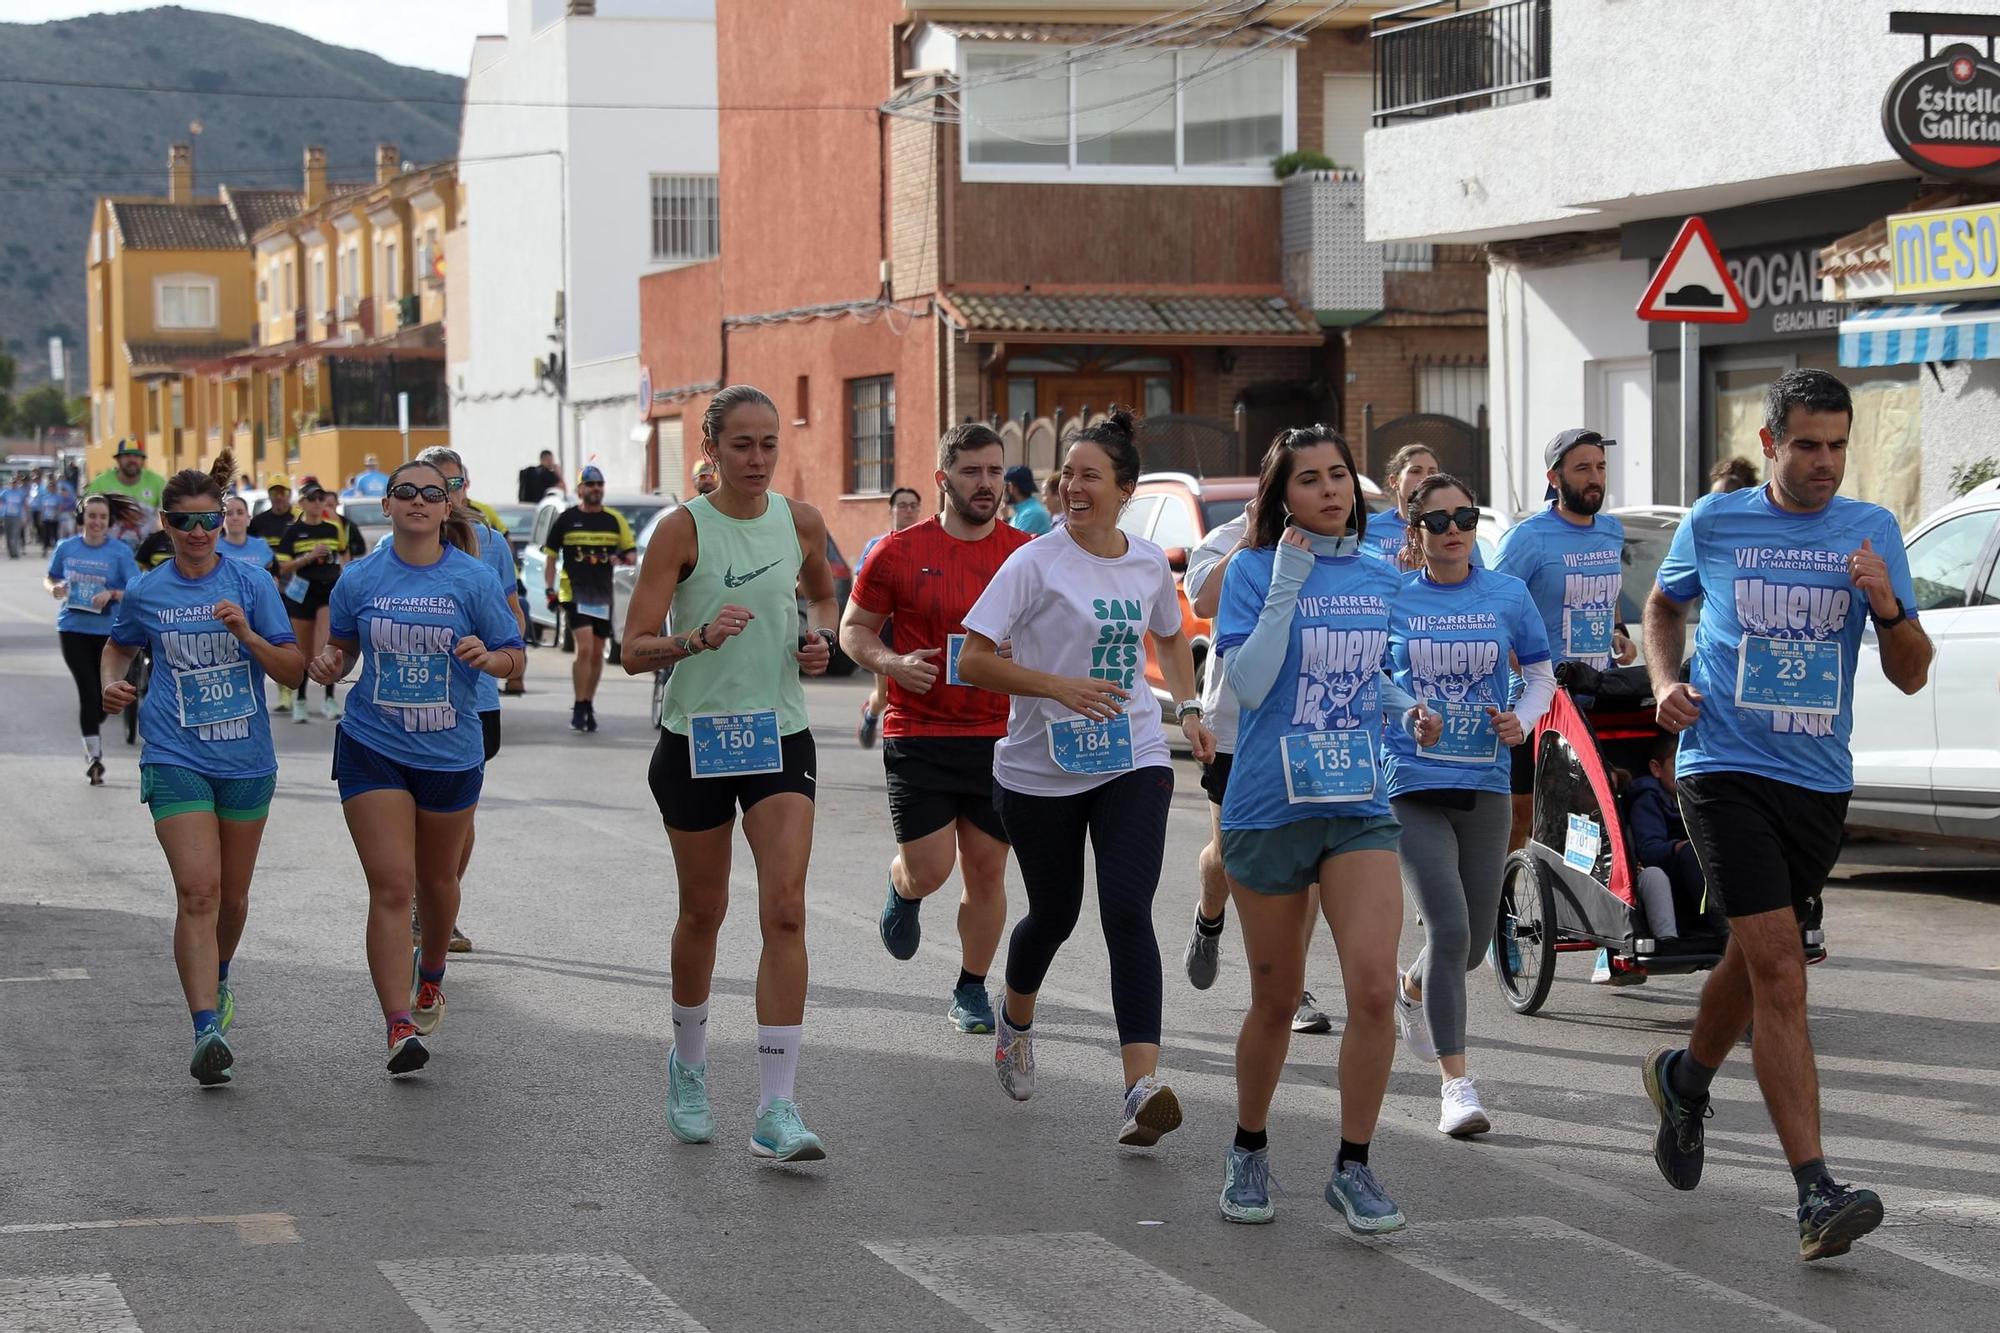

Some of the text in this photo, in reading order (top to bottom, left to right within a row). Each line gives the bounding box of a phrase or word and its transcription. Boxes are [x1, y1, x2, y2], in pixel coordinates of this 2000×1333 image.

[1917, 84, 2000, 114] Estrella
[1919, 112, 2000, 141] Galicia
[1896, 215, 2000, 286] MESO
[1773, 311, 1815, 333] GRACIA
[1380, 538, 1393, 549] VII
[1562, 553, 1577, 567] VII
[1735, 548, 1849, 569] VII CARRERA
[1760, 560, 1849, 573] Y MARCHA URBAN
[373, 597, 455, 610] VII CARRERA
[428, 607, 455, 615] URBANA
[1092, 598, 1142, 621] SAN
[1297, 596, 1385, 617] VII CARRERA
[1321, 608, 1327, 616] Y
[1330, 607, 1361, 615] MARCHA
[158, 605, 216, 625] VII CARR
[1408, 613, 1496, 631] VII CARRERA
[1436, 623, 1467, 631] MARCHA
[1591, 622, 1605, 636] 95
[1408, 638, 1499, 677] Mueve
[397, 667, 429, 684] 159
[1776, 658, 1806, 680] 23
[200, 682, 234, 703] 200
[1447, 717, 1482, 735] 127
[717, 730, 755, 749] 150
[1075, 731, 1111, 752] 184
[1315, 749, 1351, 770] 135
